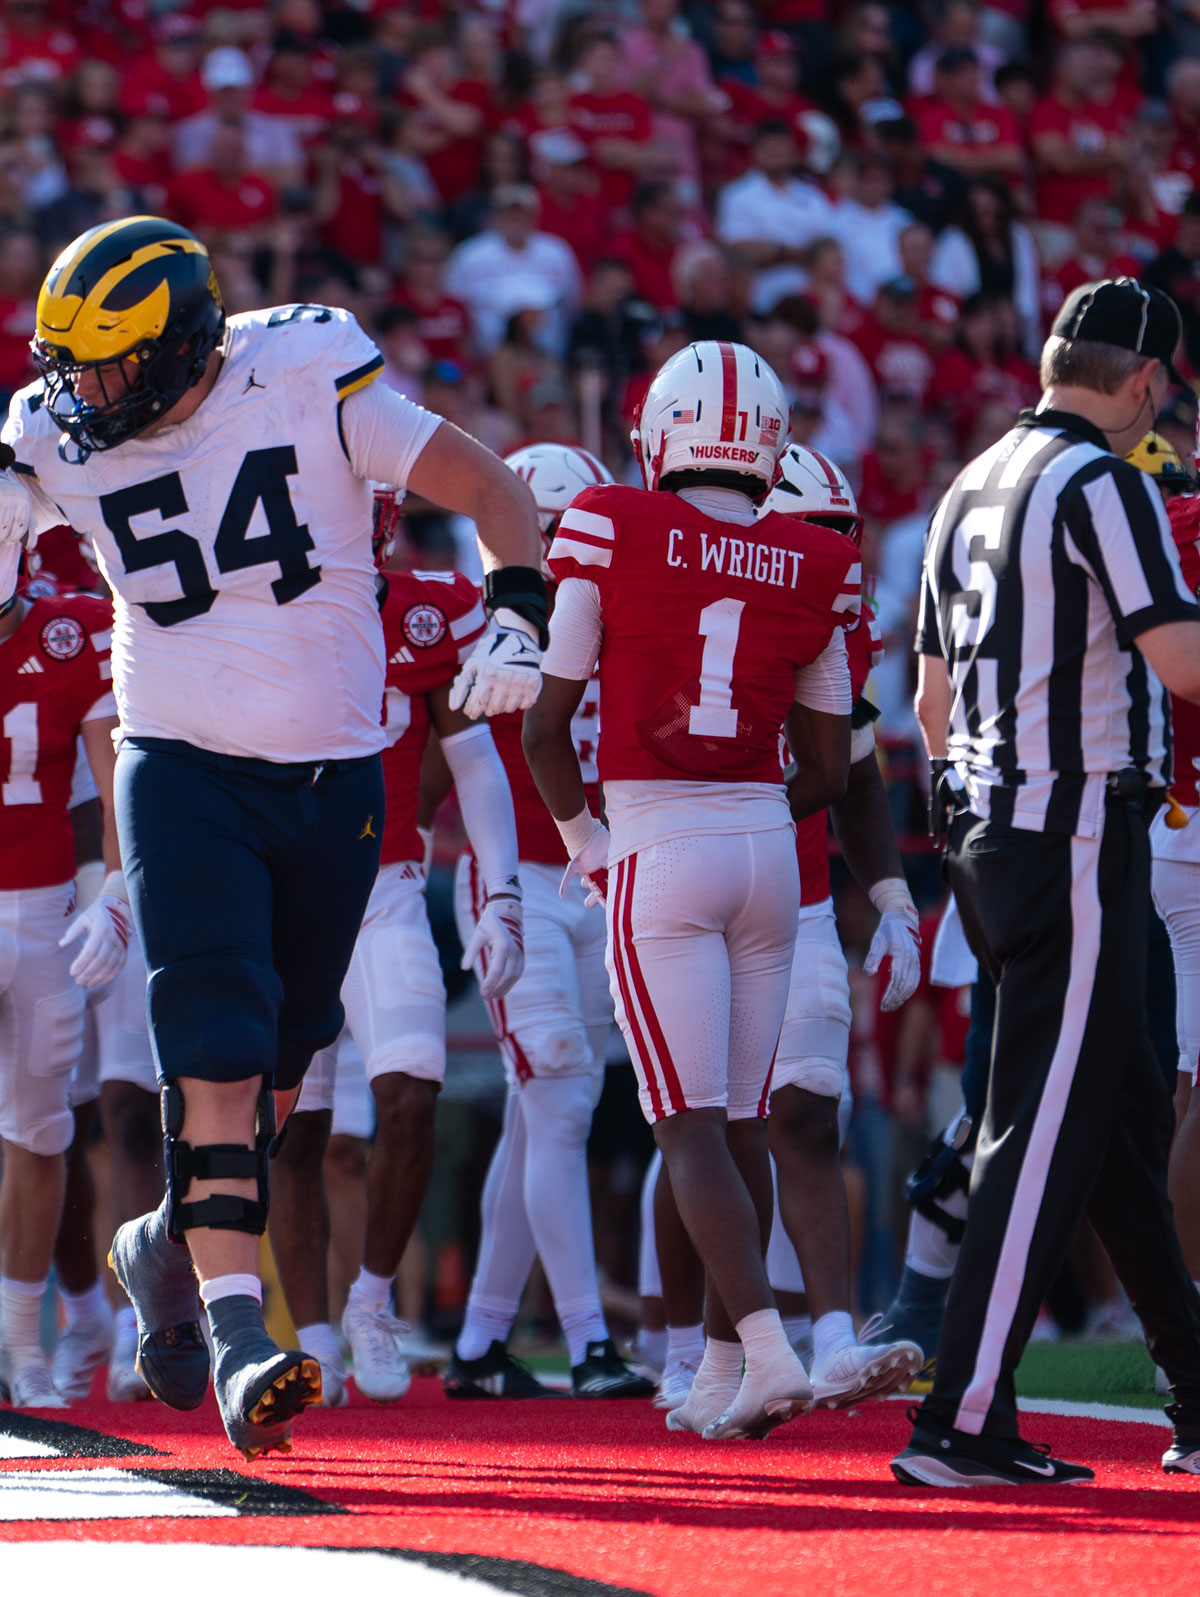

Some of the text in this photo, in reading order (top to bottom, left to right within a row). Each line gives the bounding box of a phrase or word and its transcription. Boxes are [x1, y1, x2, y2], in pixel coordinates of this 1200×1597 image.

[695, 445, 758, 464] HUSKERS
[99, 445, 323, 628] 54
[666, 528, 805, 590] C. WRIGHT
[688, 597, 747, 739] 1
